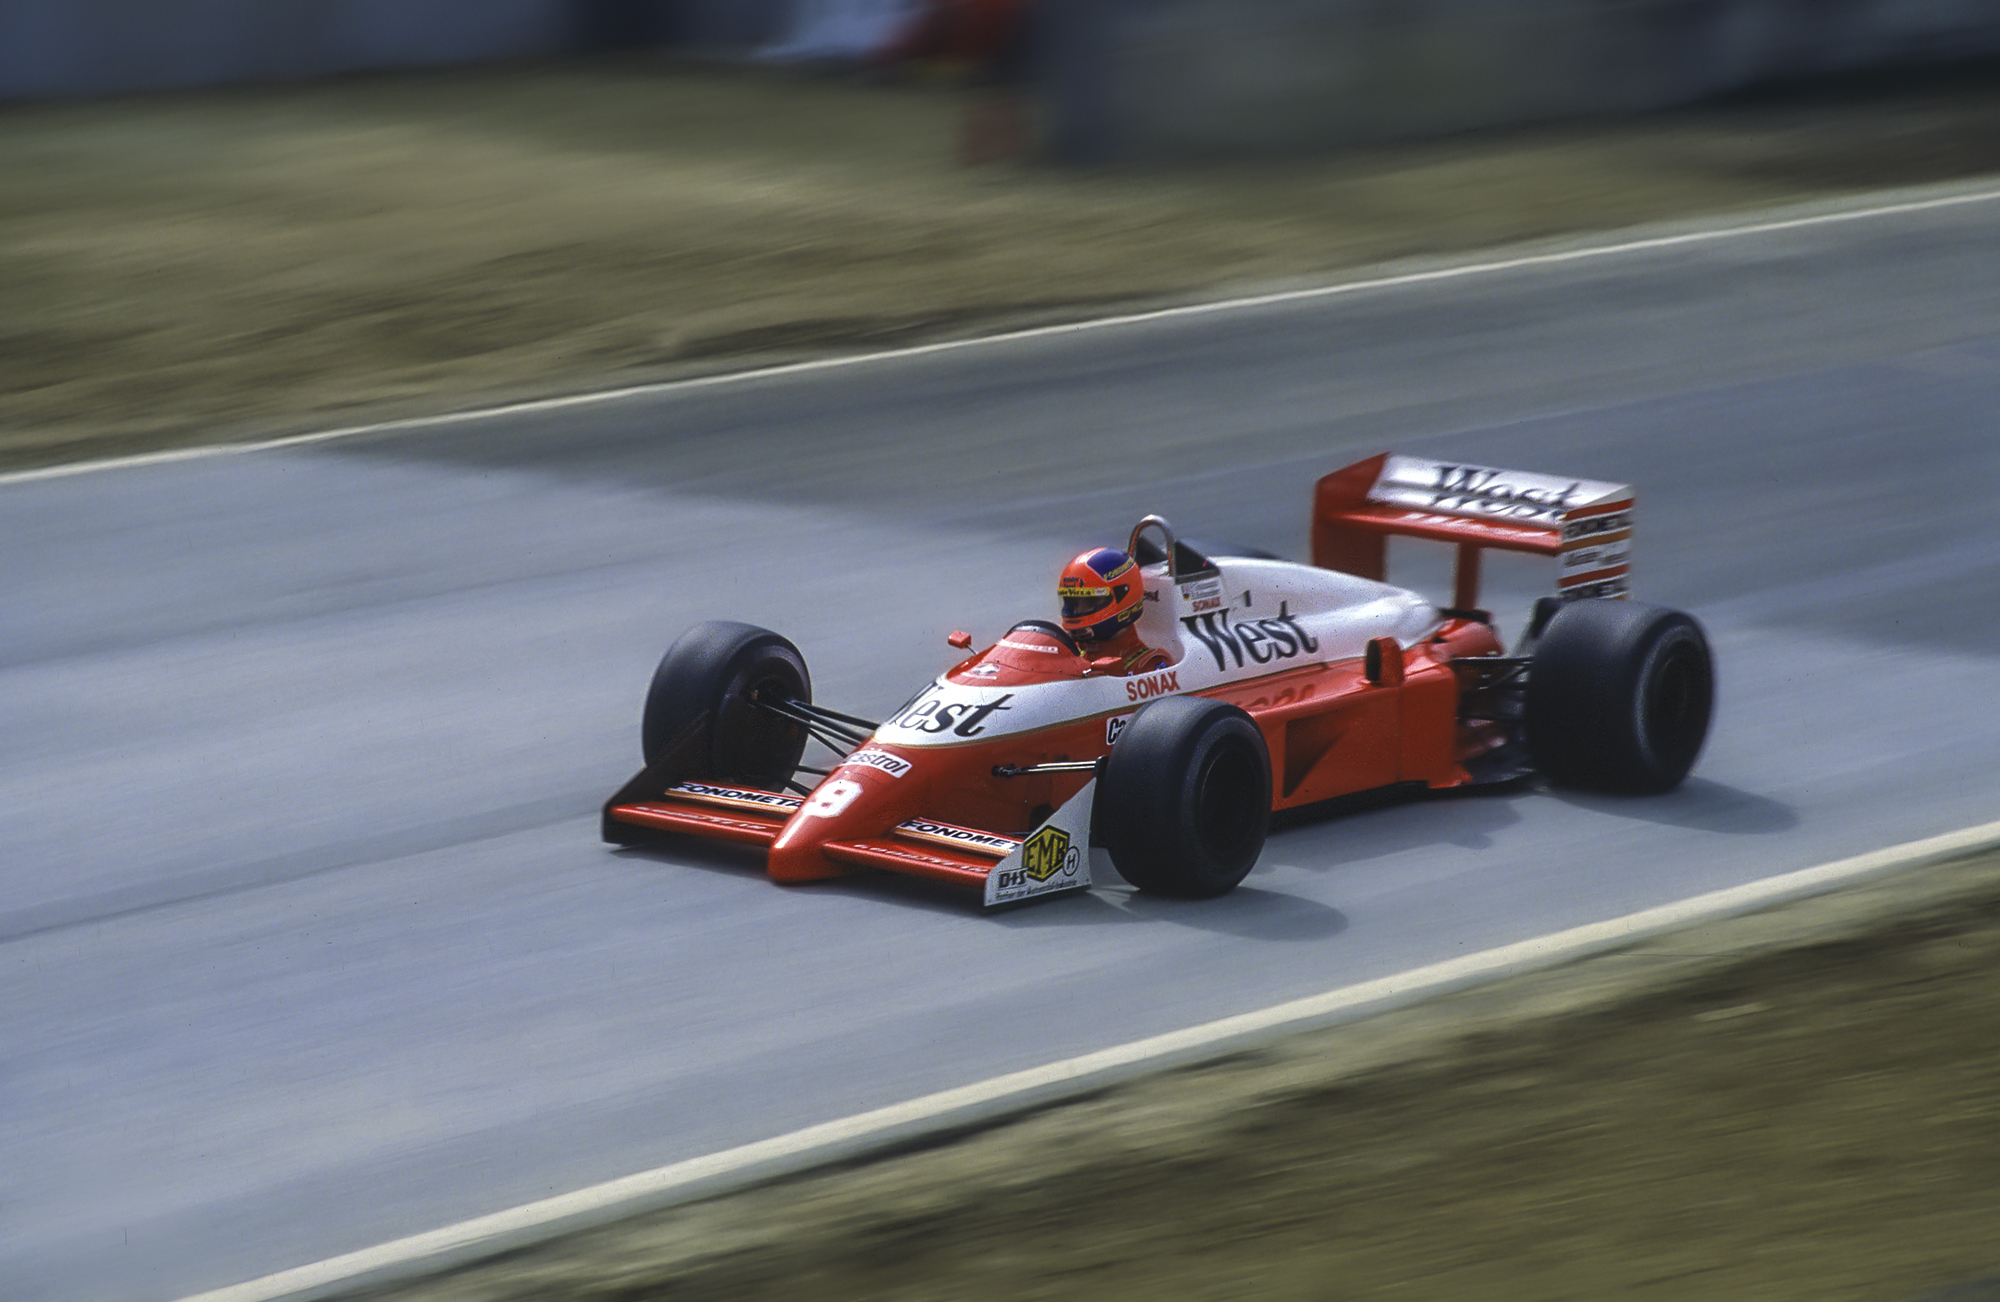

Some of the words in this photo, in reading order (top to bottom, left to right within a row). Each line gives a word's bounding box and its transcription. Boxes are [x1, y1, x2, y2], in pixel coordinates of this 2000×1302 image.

[1179, 600, 1318, 671] West
[1126, 670, 1181, 701] SONAX
[1026, 833, 1068, 875] EMB
